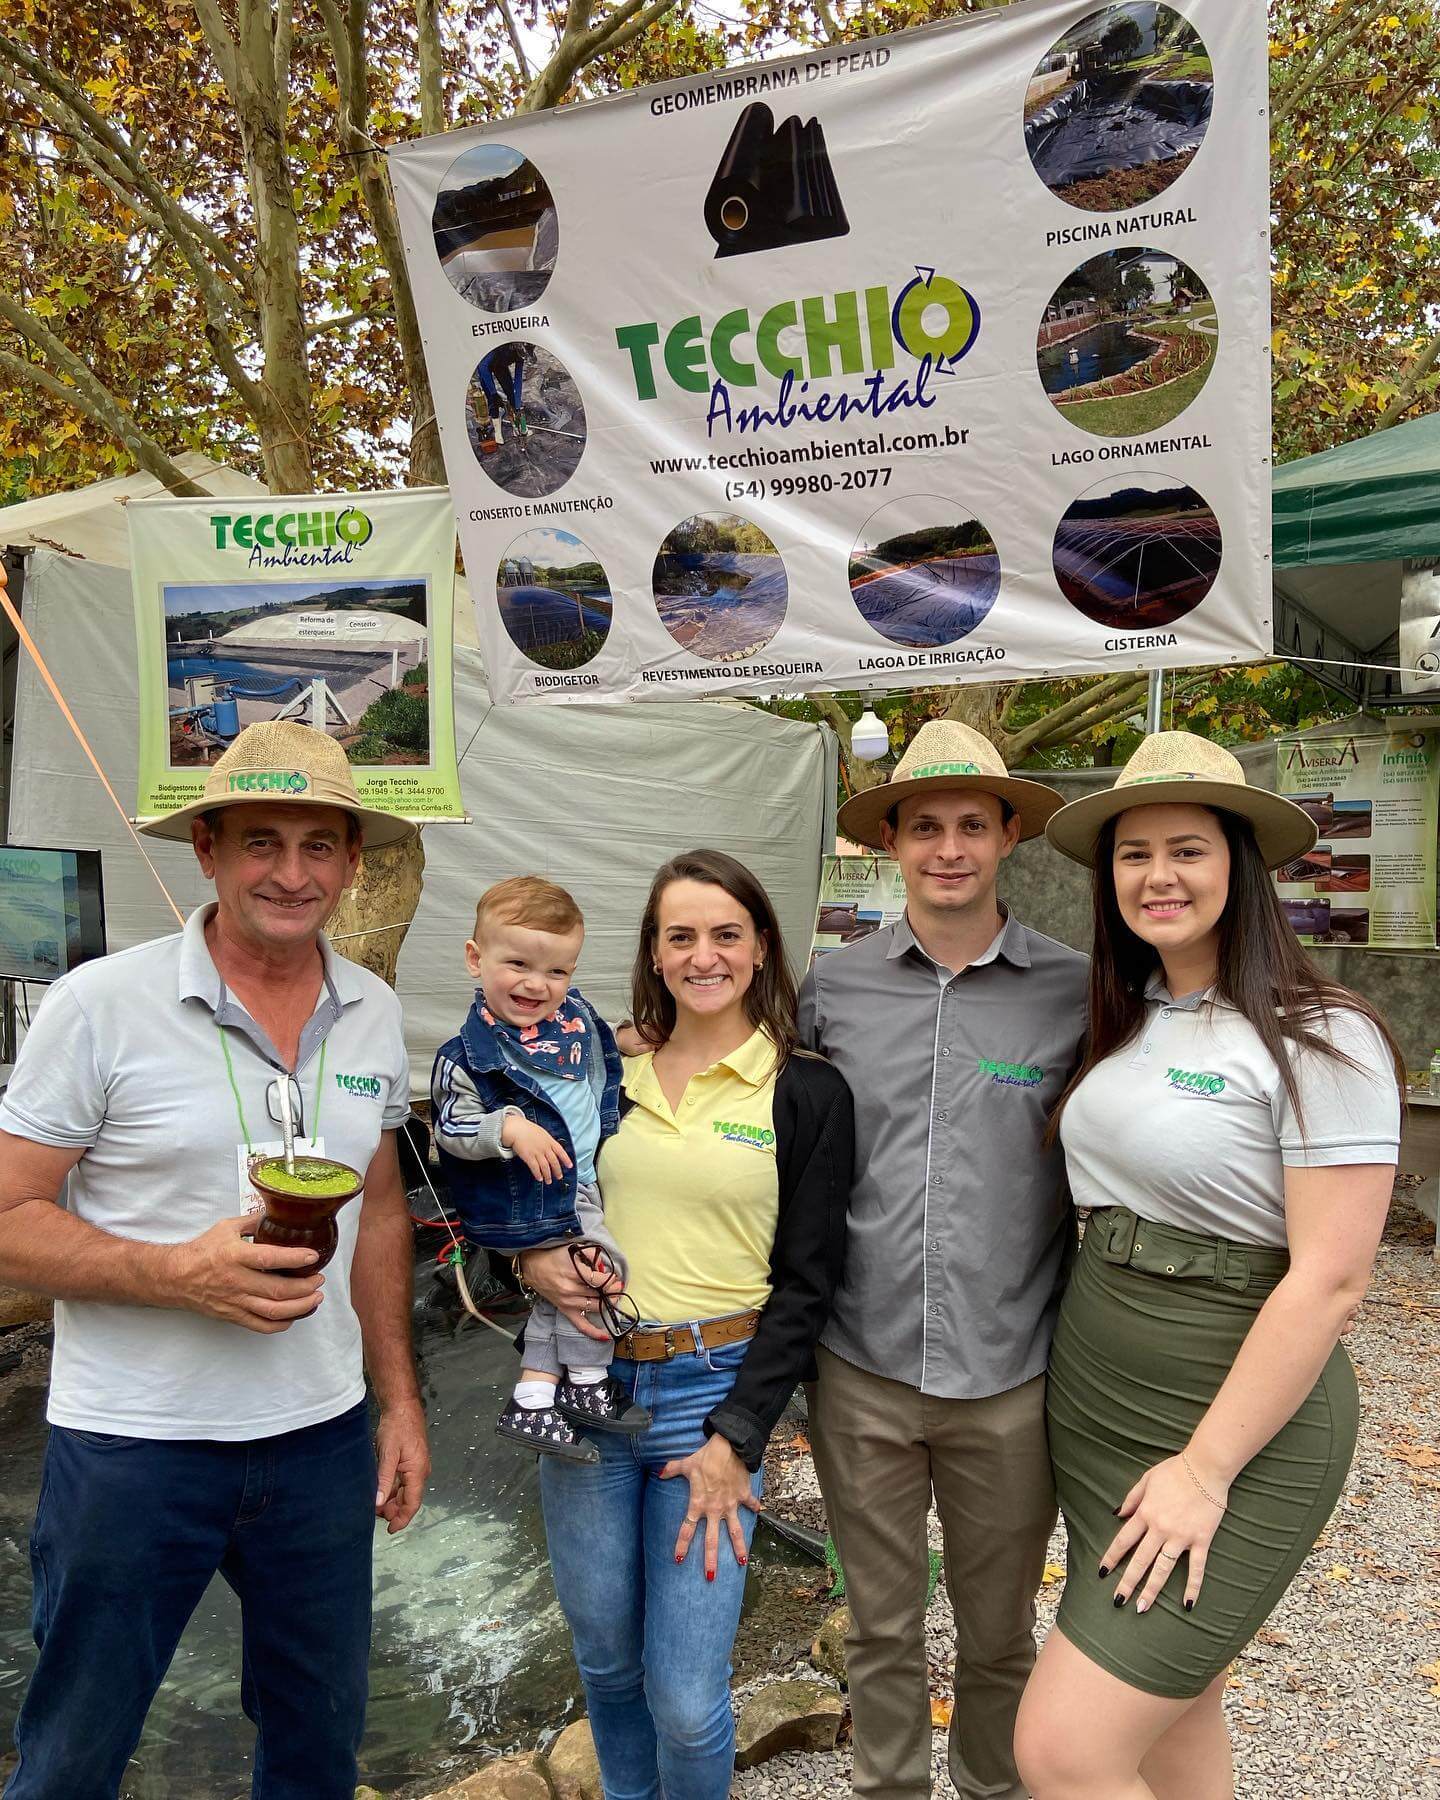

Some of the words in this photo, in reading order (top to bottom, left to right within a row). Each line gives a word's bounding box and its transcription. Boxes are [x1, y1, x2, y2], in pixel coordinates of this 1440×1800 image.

[650, 67, 800, 116] GEOMEMBRANA
[805, 59, 832, 82] DE
[836, 47, 891, 75] PEAD
[1046, 222, 1112, 247] PISCINA
[1116, 207, 1197, 235] NATURAL
[471, 315, 550, 337] ESTERQUEIRA
[615, 266, 981, 401] TECCHIO
[706, 352, 937, 438] Ambiental
[650, 424, 970, 475] www.tecchioambiental.com.br
[1051, 449, 1094, 466] LAGO
[1098, 434, 1212, 460] ORNAMENTAL
[725, 478, 767, 501] (54)
[770, 467, 893, 497] 99980-2077
[469, 505, 523, 522] CONSERTO
[525, 505, 531, 516] E
[533, 496, 614, 516] MANUTENÇÃO
[210, 505, 373, 549] TECCHIO
[248, 541, 354, 568] Ambiental
[299, 616, 325, 624] Reforma
[327, 616, 335, 624] de
[298, 629, 336, 637] esterqueiras
[1104, 633, 1178, 651] CISTERNA
[858, 655, 905, 670] LAGOA
[908, 653, 927, 667] DE
[929, 646, 1006, 665] IRRIGAÇÃO
[534, 673, 600, 687] BIODIGETOR
[641, 667, 732, 683] REVESTIMENTO
[734, 666, 750, 678] DE
[752, 661, 824, 677] PESQUEIRA
[1383, 752, 1432, 766] Infinity
[158, 784, 198, 792] Biodigestores
[229, 771, 308, 793] TECCHIO
[366, 778, 388, 787] Jorge
[389, 778, 419, 786] Tecchio
[395, 787, 404, 795] 54
[177, 793, 205, 801] orçament
[976, 1058, 1044, 1083] TECCHIO
[1164, 1068, 1226, 1095] TECCHIO
[336, 1073, 381, 1095] TECCHIO
[713, 1121, 775, 1145] TECCHIO
[721, 1133, 765, 1148] Ambiental
